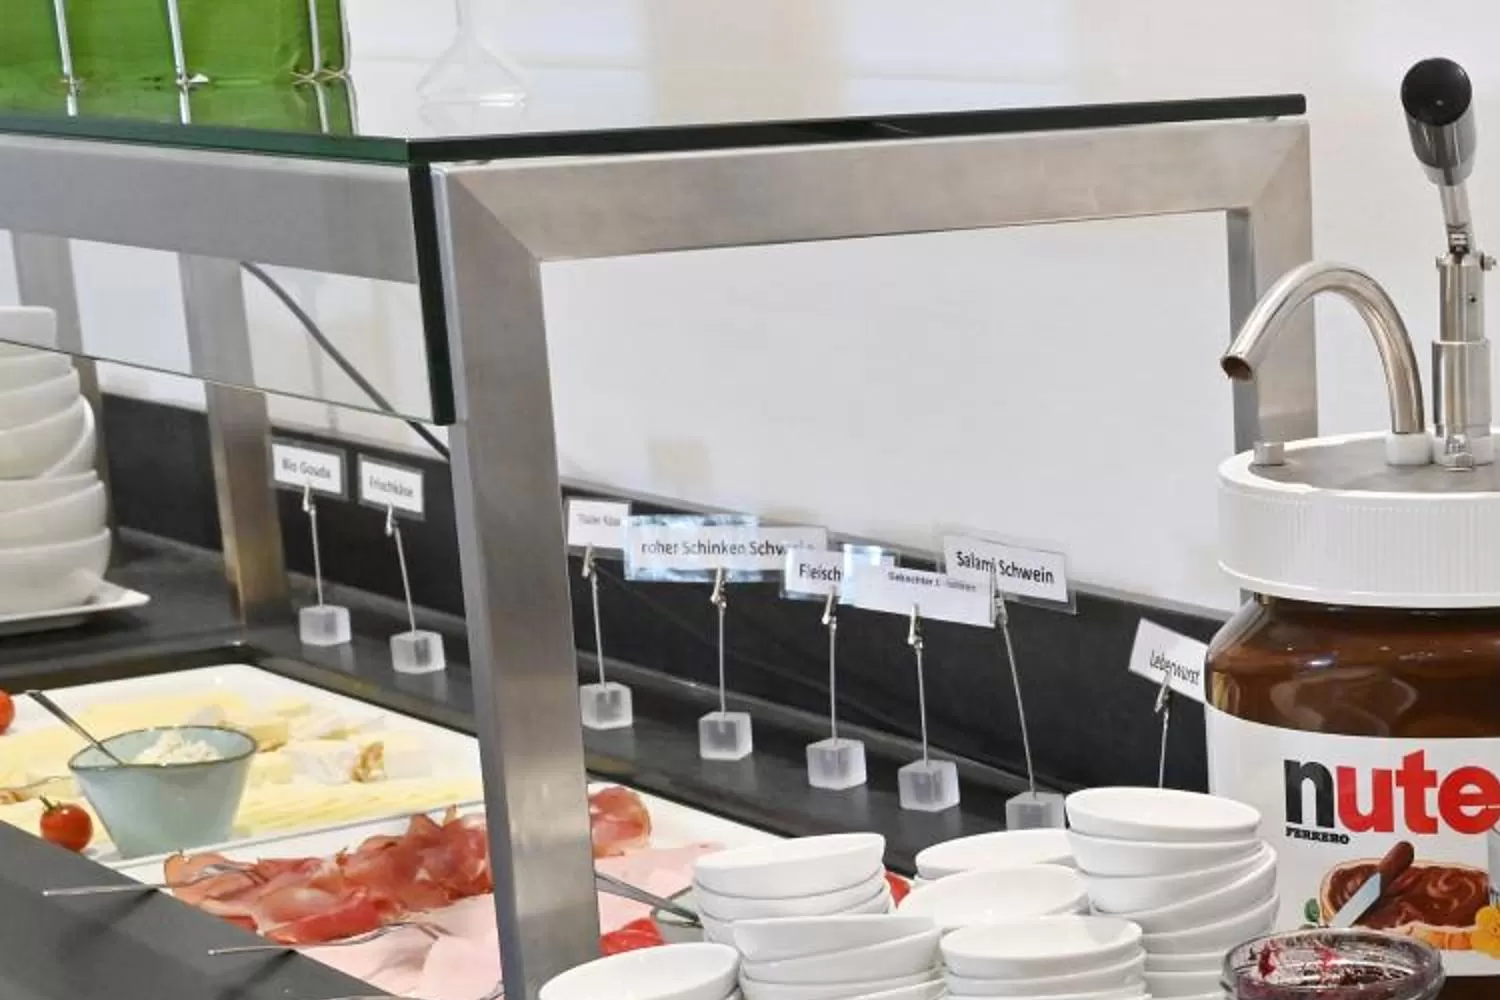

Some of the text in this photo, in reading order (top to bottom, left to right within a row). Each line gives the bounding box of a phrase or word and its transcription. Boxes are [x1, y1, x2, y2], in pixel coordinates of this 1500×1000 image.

[300, 460, 331, 479] Gouda
[682, 538, 746, 557] Schinken
[956, 550, 1055, 585] Salami Schwein
[1285, 826, 1350, 845] FERRERO
